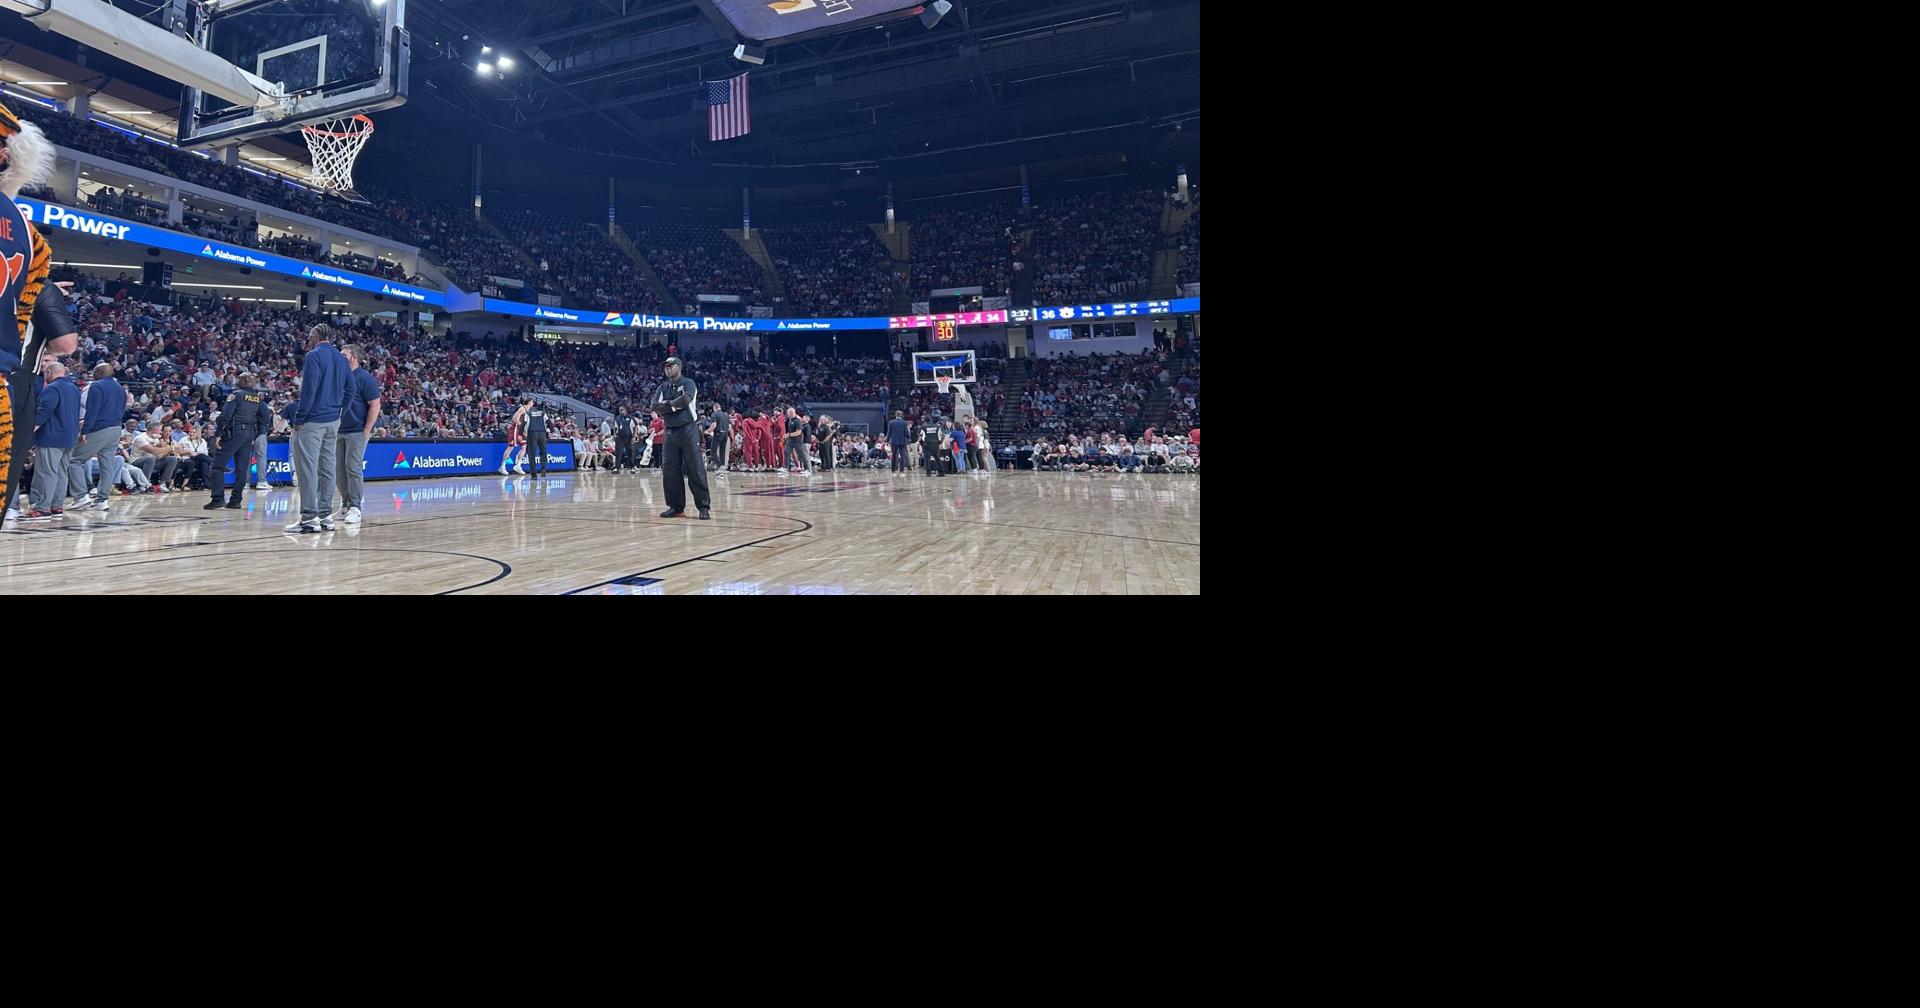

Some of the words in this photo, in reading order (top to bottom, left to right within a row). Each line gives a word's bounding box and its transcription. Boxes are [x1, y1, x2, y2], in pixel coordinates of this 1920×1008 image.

[43, 204, 130, 239] Power
[214, 249, 246, 263] Alabama
[245, 255, 267, 267] Power
[986, 313, 1000, 322] 34
[1041, 310, 1056, 320] 36
[630, 313, 699, 330] Alabama
[703, 316, 754, 331] Power
[937, 327, 954, 339] 30
[412, 456, 455, 469] Alabama
[456, 455, 483, 467] Power
[546, 454, 567, 464] Power
